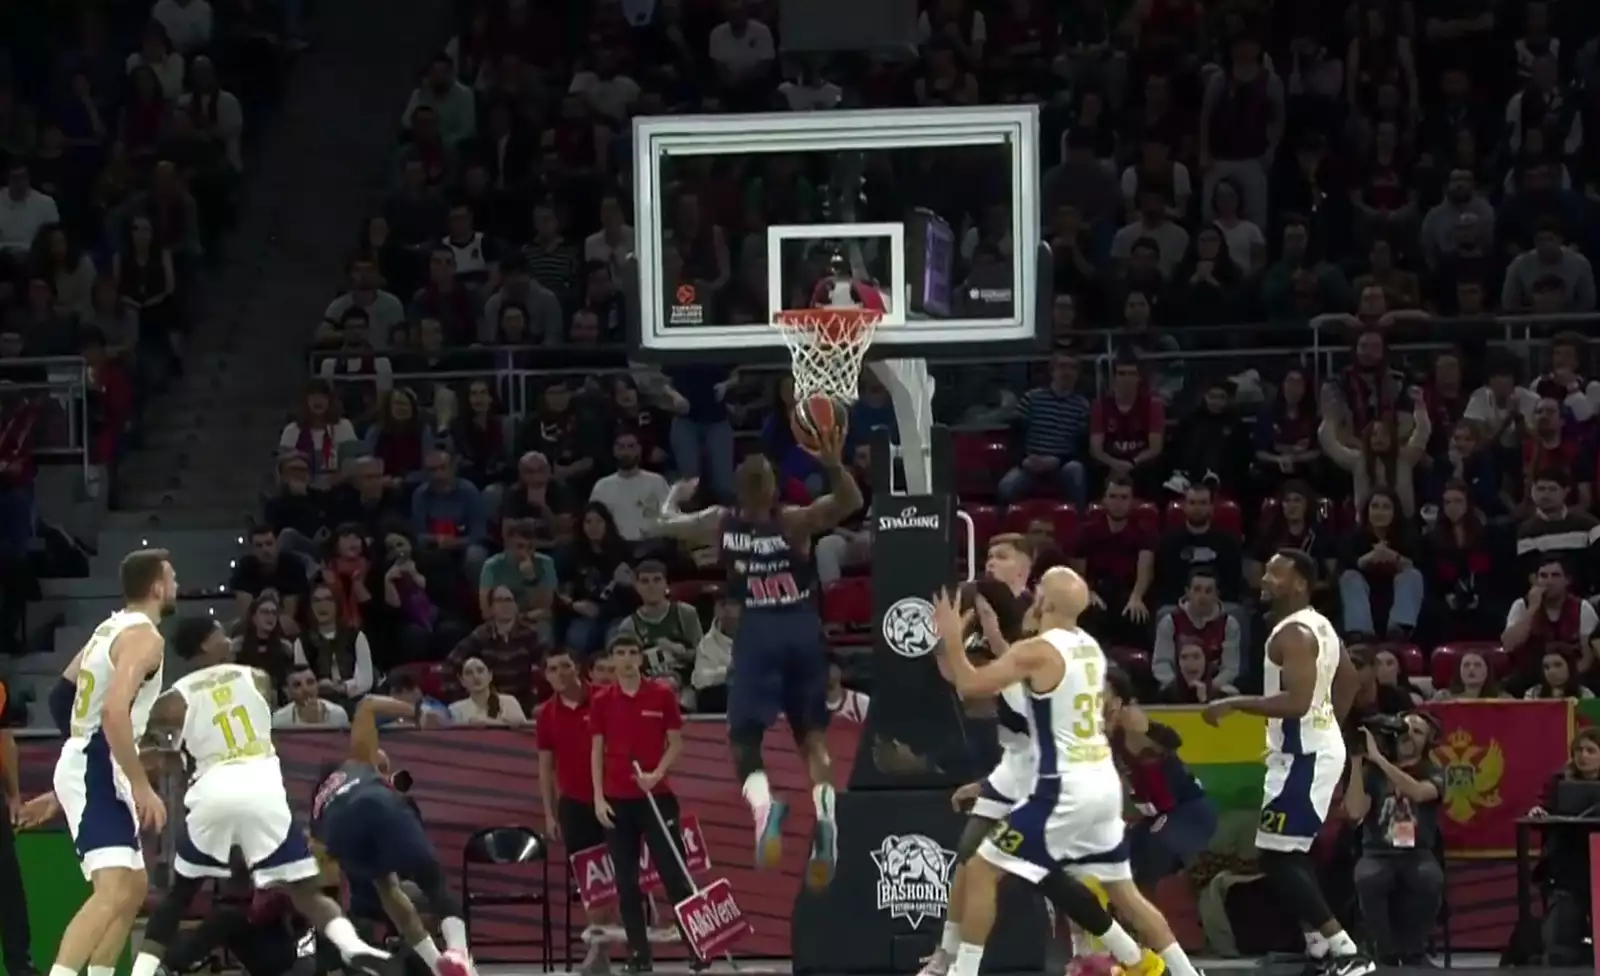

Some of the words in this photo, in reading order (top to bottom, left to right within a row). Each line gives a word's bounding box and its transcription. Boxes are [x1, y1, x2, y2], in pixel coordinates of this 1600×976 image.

[879, 514, 939, 530] SPALDING
[212, 704, 257, 750] 11
[687, 892, 741, 944] AlkiVent
